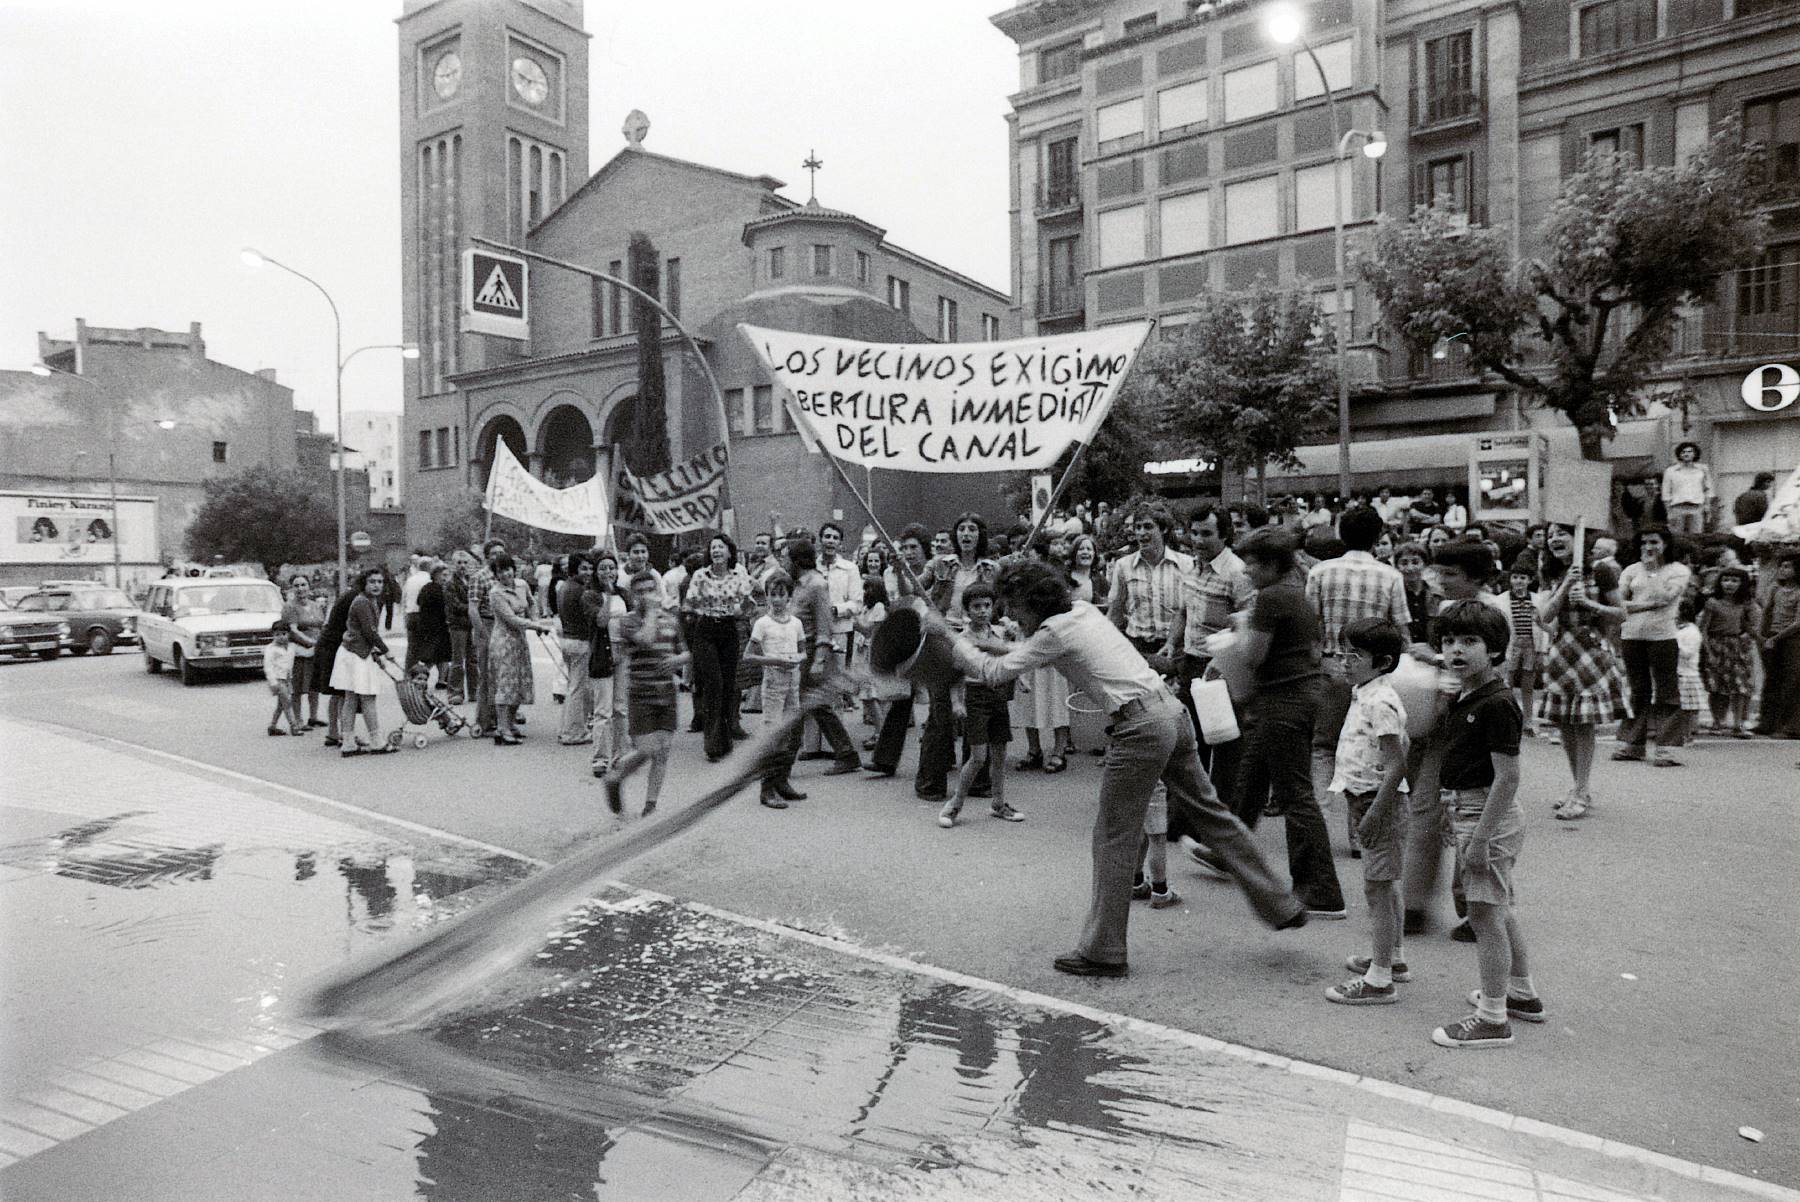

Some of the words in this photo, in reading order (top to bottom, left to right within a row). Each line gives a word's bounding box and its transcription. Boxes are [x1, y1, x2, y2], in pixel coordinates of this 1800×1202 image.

[765, 342, 826, 376] LOS
[836, 345, 975, 386] VECINOS
[990, 346, 1137, 387] EXIGIMO
[796, 389, 932, 426] BERTURA
[951, 380, 1109, 425] INMEDIAT
[836, 423, 900, 458] DEL
[918, 427, 1042, 463] CANAL
